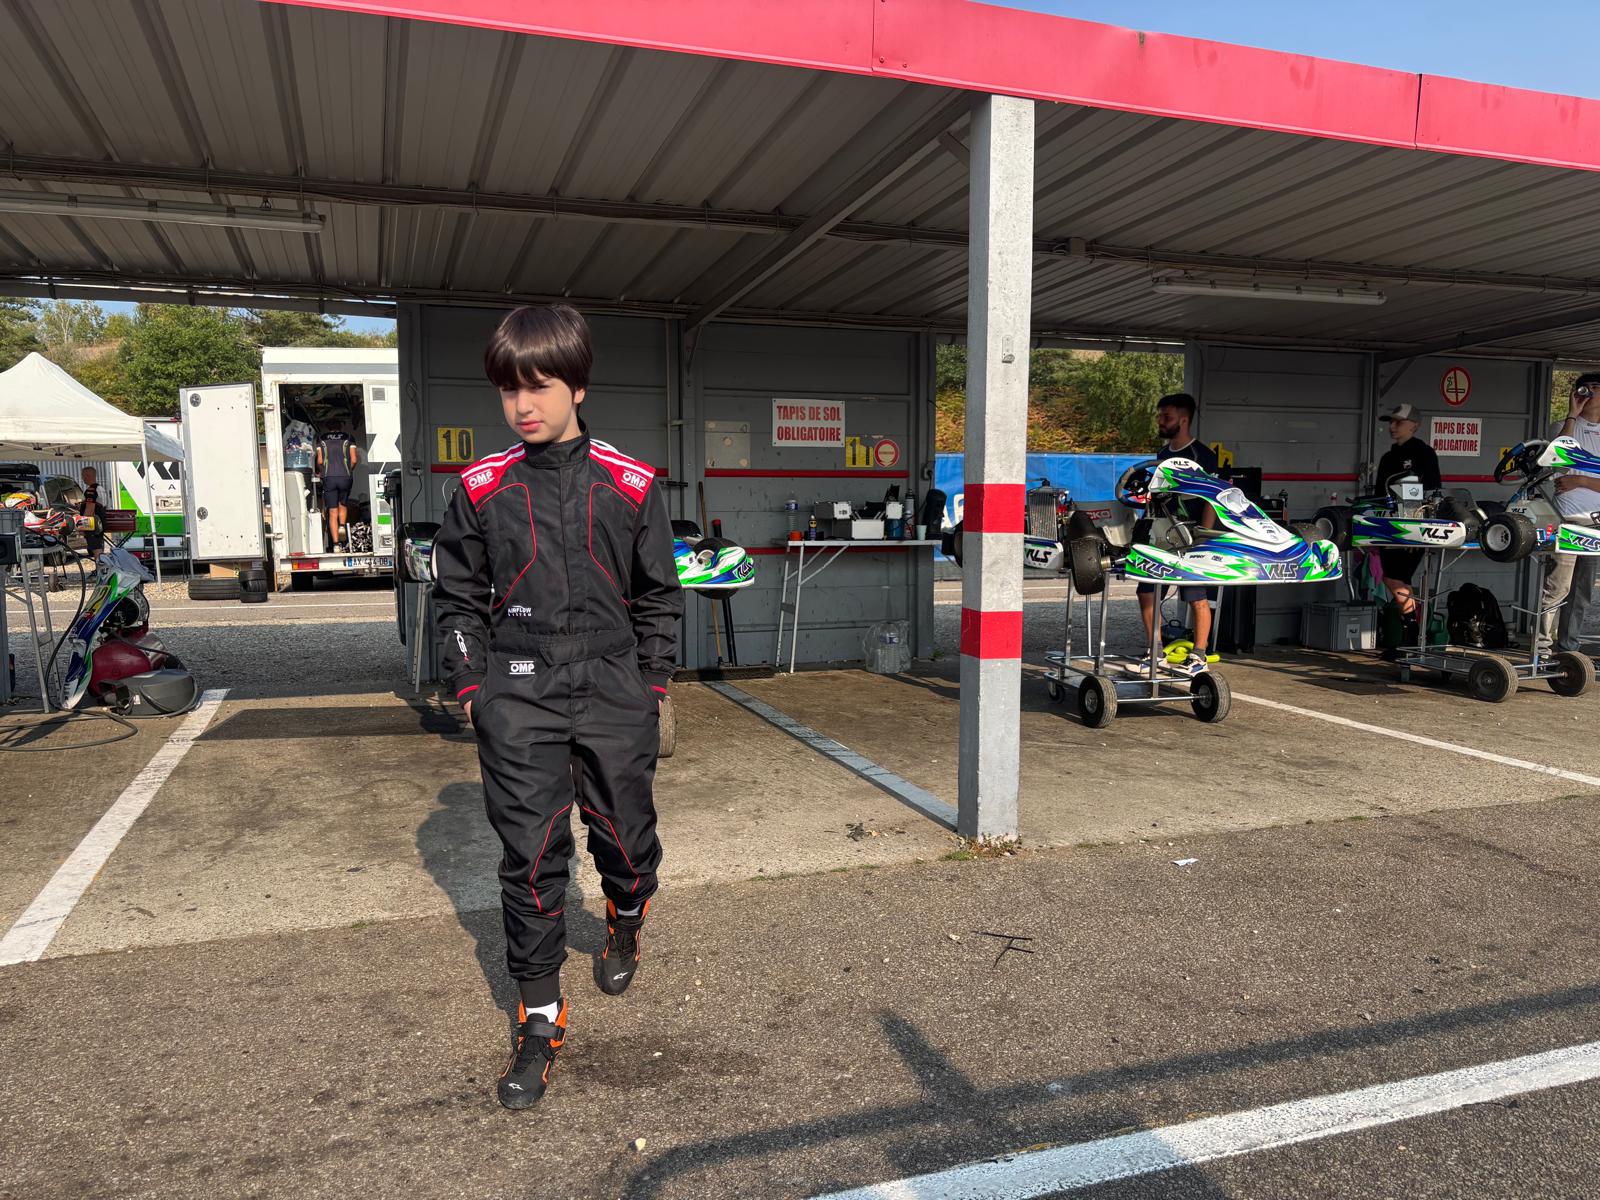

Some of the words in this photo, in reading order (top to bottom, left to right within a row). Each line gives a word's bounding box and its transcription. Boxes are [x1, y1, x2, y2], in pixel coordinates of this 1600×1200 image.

[777, 405, 806, 421] TAPIS
[808, 406, 822, 421] DE
[823, 406, 842, 422] SOL
[776, 426, 842, 442] OBLIGATOIRE
[1434, 422, 1455, 434] TAPIS
[1456, 422, 1466, 435] DE
[1466, 422, 1479, 435] SOL
[442, 429, 472, 460] 10
[1433, 439, 1478, 452] OBLIGATOIRE
[468, 471, 493, 487] OMP
[622, 472, 646, 488] OMP
[510, 663, 535, 673] OMP
